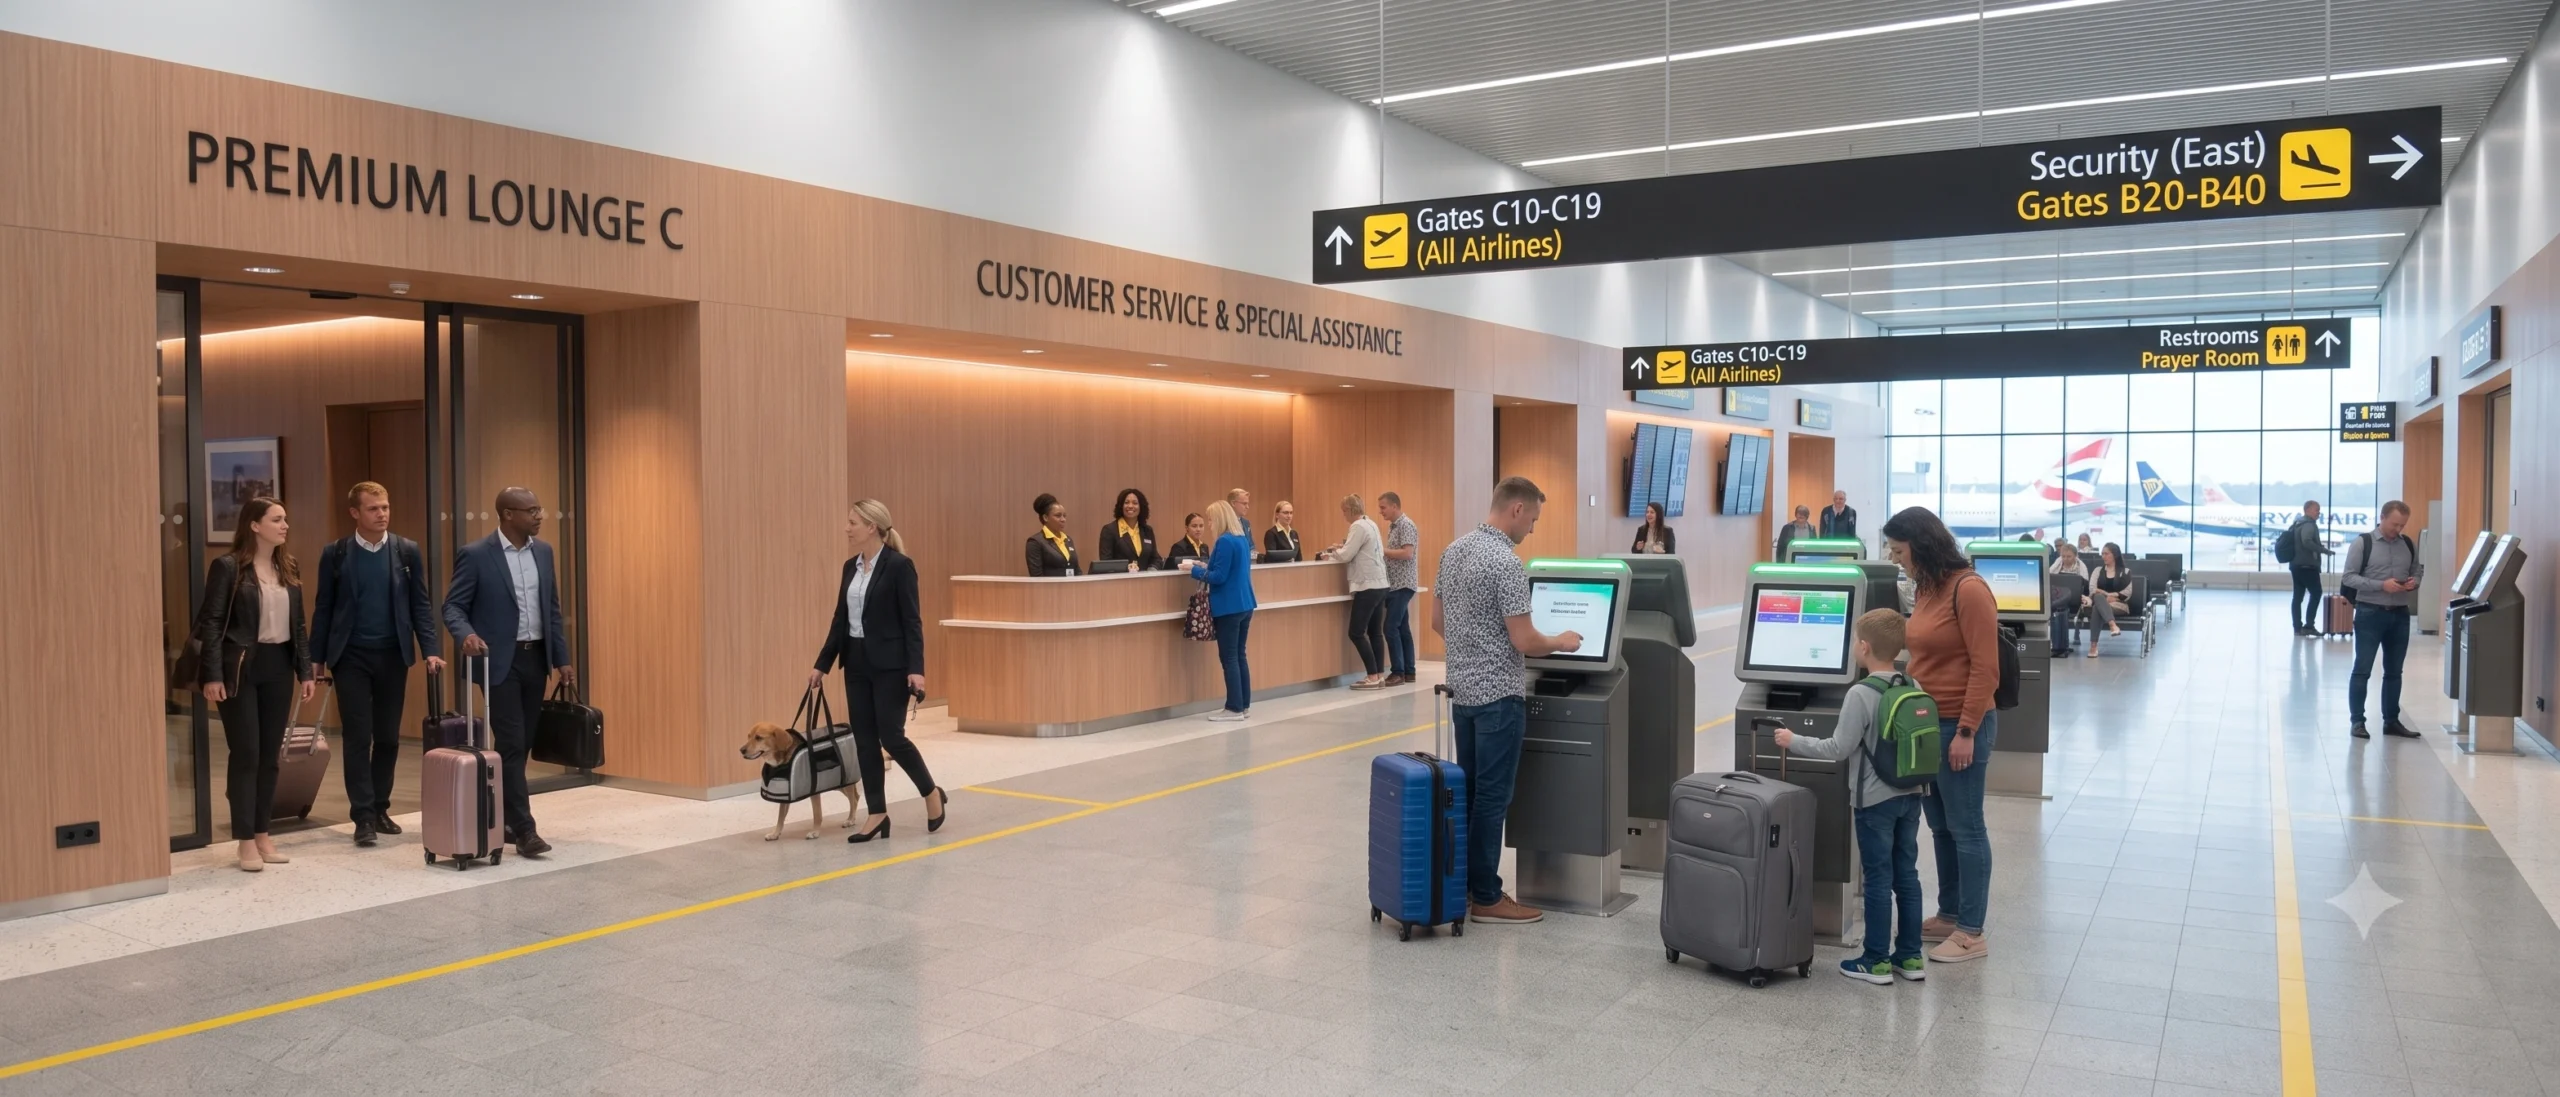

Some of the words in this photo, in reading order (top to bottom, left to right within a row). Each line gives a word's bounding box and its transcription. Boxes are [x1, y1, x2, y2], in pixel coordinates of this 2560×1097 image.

[2030, 143, 2159, 181] Security
[2170, 130, 2266, 175] (East)
[187, 130, 448, 218] PREMIUM
[468, 174, 646, 246] LOUNGE
[659, 207, 685, 251] C
[2017, 189, 2109, 221] Gates
[2121, 174, 2266, 214] B20-B40
[1416, 207, 1484, 233] Gates
[1492, 191, 1602, 227] C10-C19
[1417, 239, 1456, 271] (All
[1462, 228, 1562, 262] Airlines)
[976, 259, 1116, 315] CUSTOMER
[1122, 283, 1209, 328] SERVICE
[1215, 299, 1230, 332] &
[1235, 302, 1308, 343] SPECIAL
[1310, 316, 1403, 356] ASSISTANCE
[1690, 348, 1734, 365] Gates
[1739, 344, 1807, 362] C10-C19
[2160, 329, 2259, 347] Restrooms
[1691, 367, 1715, 386] (All
[1719, 364, 1782, 384] Airlines)
[2141, 351, 2200, 372] Prayer
[2205, 350, 2260, 367] Room
